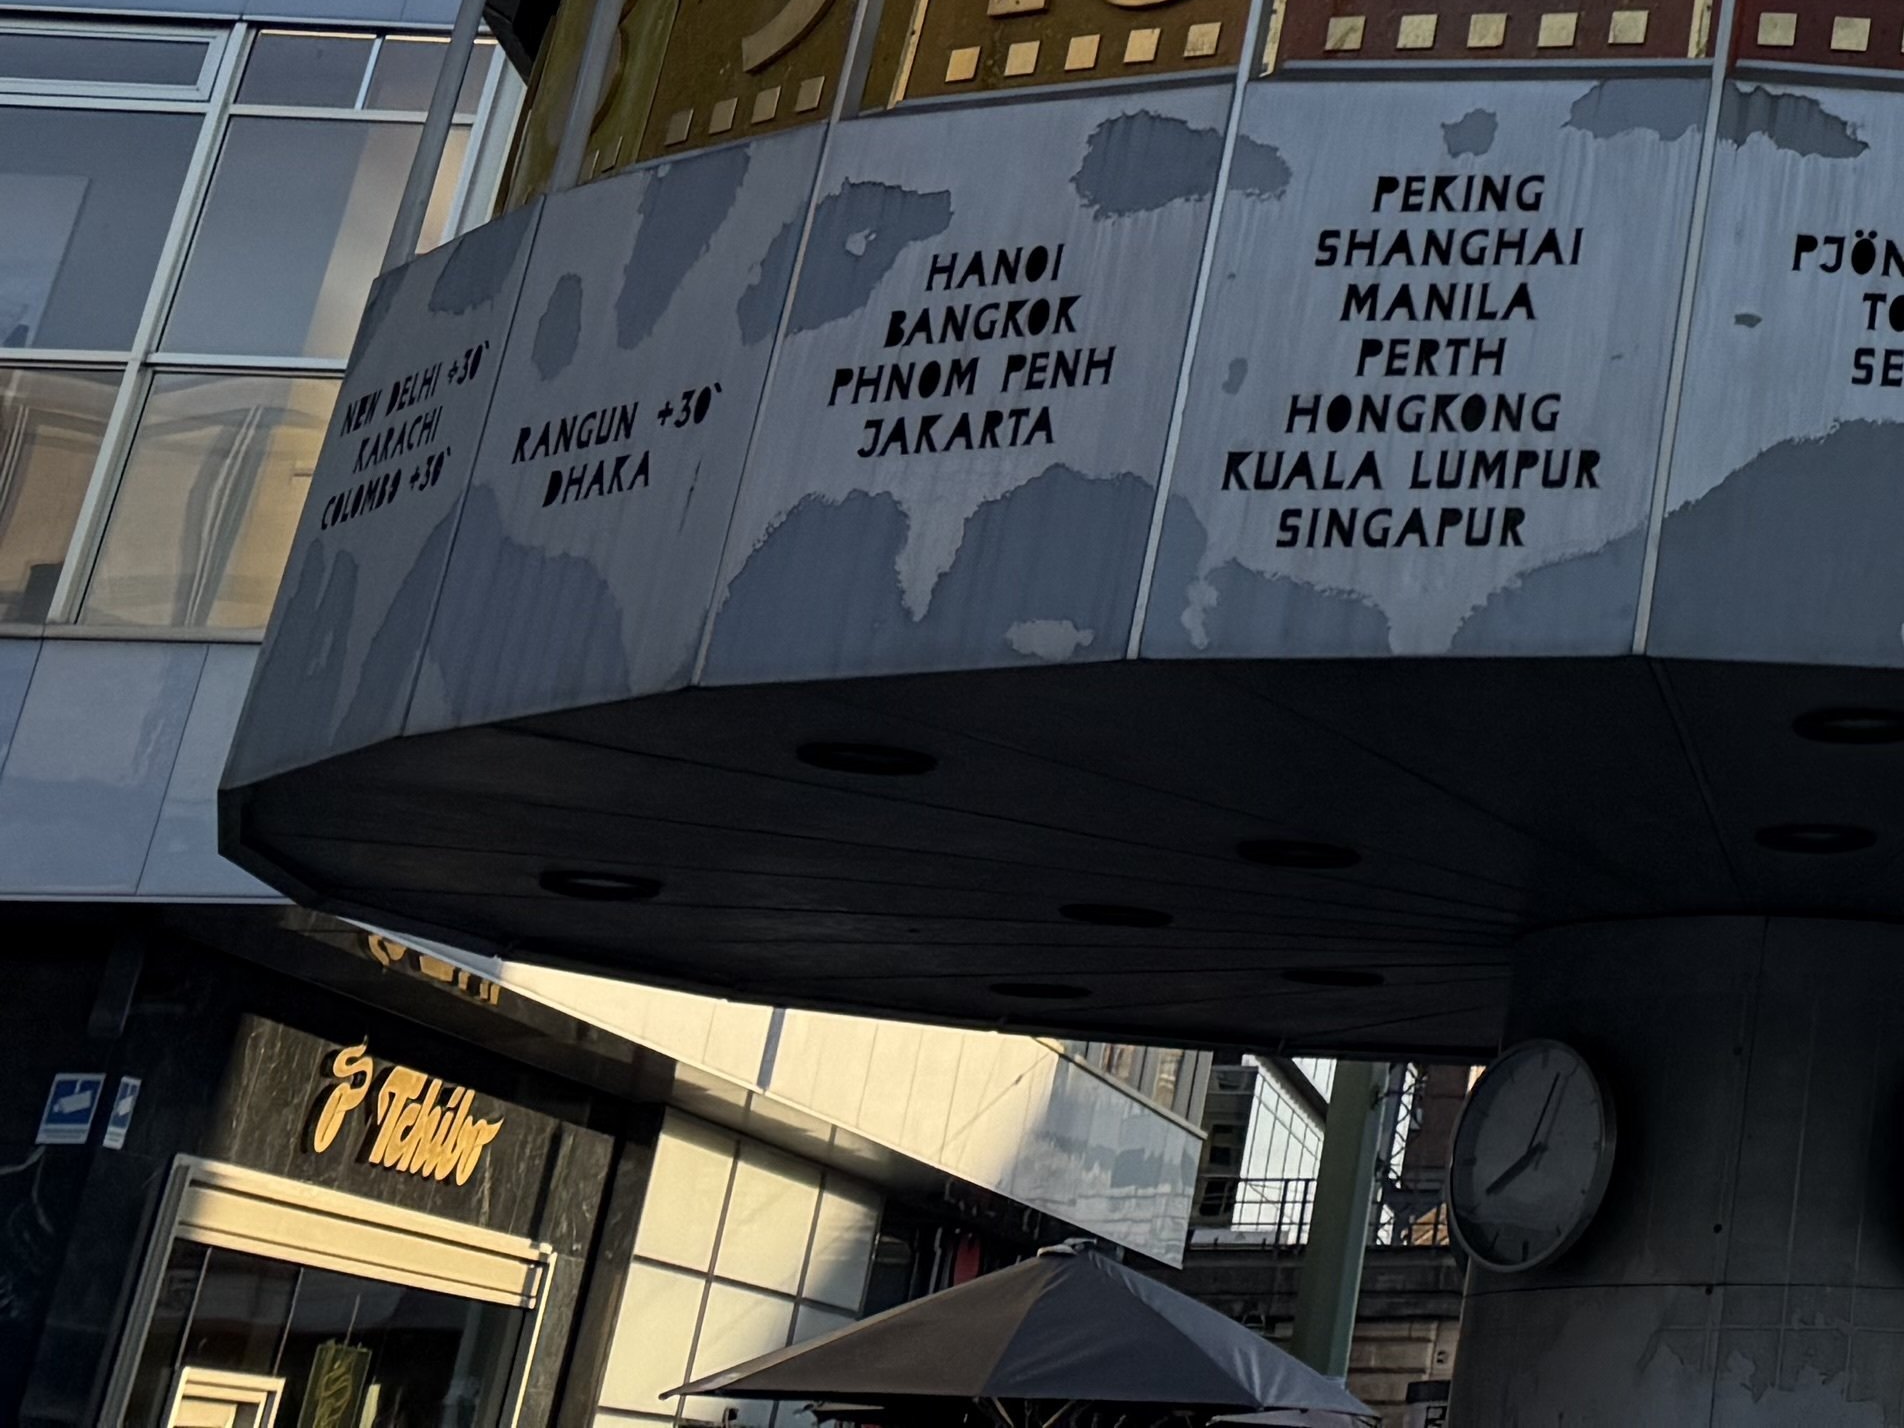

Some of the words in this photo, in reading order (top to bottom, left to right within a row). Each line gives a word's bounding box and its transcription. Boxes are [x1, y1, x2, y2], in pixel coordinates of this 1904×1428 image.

[1371, 174, 1545, 213] PEKING
[925, 244, 1065, 291] HANOI
[1315, 228, 1583, 267] SHANGHAI
[884, 294, 1081, 348] BANGKOK
[1340, 282, 1536, 321] MANILA
[827, 355, 979, 407] PHNOM
[1000, 346, 1116, 394] PENH
[1355, 339, 1505, 377] PERTH
[387, 362, 441, 417] DELHI
[512, 403, 638, 464] RANGUN
[857, 406, 1055, 458] JAKARTA
[1285, 393, 1562, 434] HONGKONG
[542, 451, 650, 508] DHAKA
[1221, 450, 1384, 491] KUALA
[1409, 450, 1601, 490] LUMPUR
[1276, 507, 1526, 548] SINGAPUR
[368, 1065, 505, 1187] Tchibo
